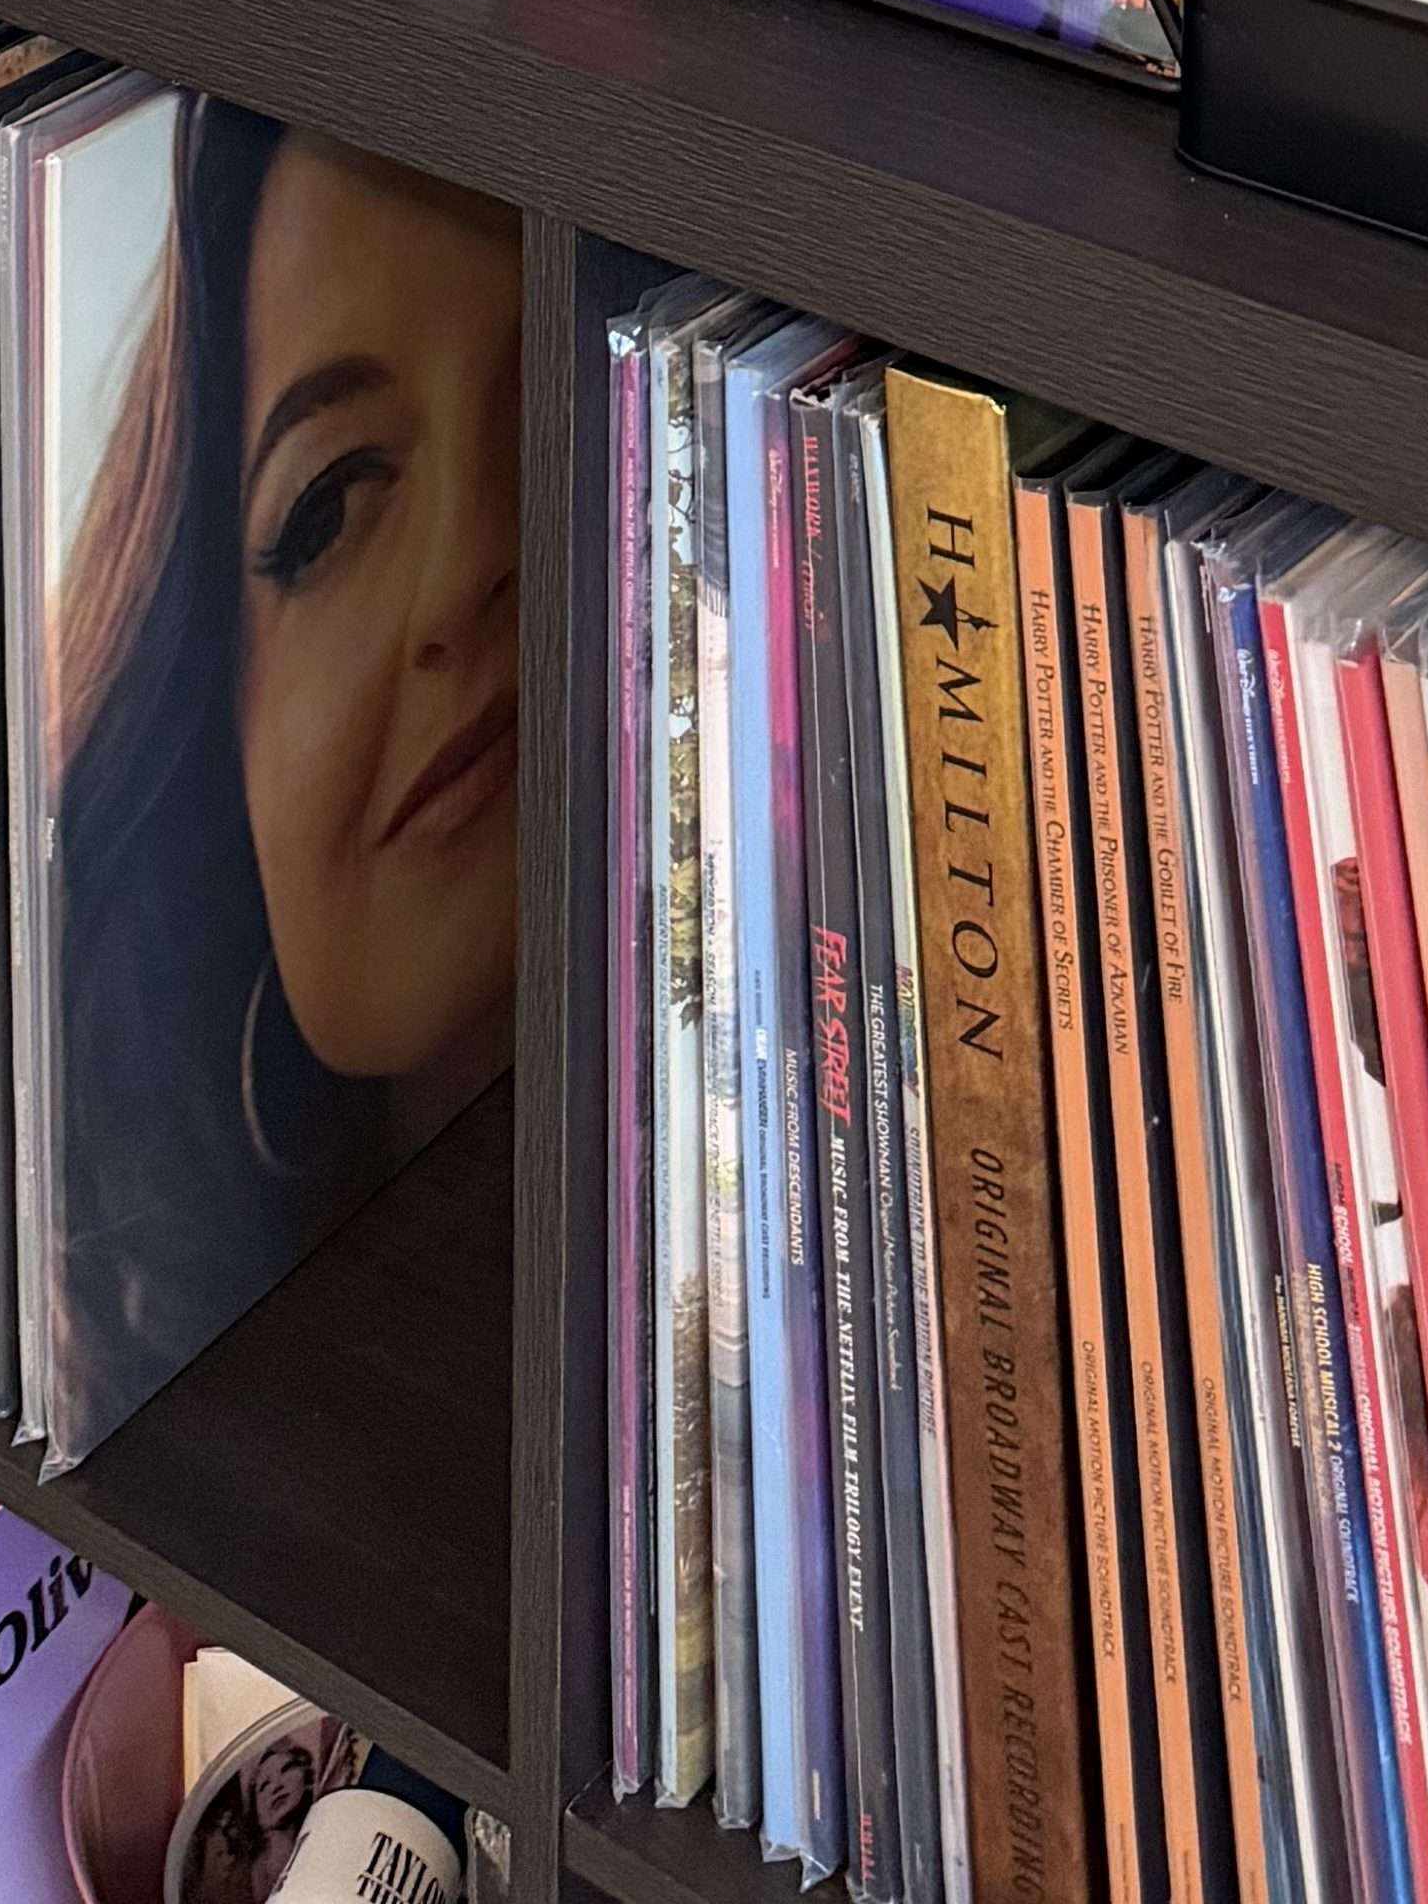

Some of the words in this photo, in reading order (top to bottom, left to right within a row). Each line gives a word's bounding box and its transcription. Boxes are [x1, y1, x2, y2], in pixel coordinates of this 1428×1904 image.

[1030, 590, 1052, 658] HARRY
[1079, 603, 1105, 672] HARRY
[1138, 615, 1160, 683] HARRY
[1034, 663, 1058, 739] POTTER
[1086, 678, 1110, 755] POTTER
[1143, 689, 1168, 766] POTTER
[1040, 744, 1056, 779] AND
[1093, 760, 1108, 794] AND
[1150, 772, 1166, 807] AND
[1043, 786, 1058, 813] THE
[1095, 800, 1110, 830] THE
[1153, 813, 1169, 841] THE
[1044, 820, 1069, 915] CHAMBER
[1096, 835, 1122, 928] PRISONER
[1156, 847, 1179, 927] GOBLET
[1052, 920, 1067, 945] OF
[1105, 932, 1120, 957] OF
[1162, 931, 1179, 957] OF
[811, 926, 850, 1015] FEAR
[869, 983, 884, 1012] THE
[1051, 948, 1077, 1030] SECRETS
[1165, 961, 1185, 1004] FIRE
[1107, 962, 1131, 1054] AZKABAN
[784, 1048, 799, 1099] MUSIC
[816, 1018, 853, 1128] STREET
[870, 1017, 888, 1095] GREATEST
[786, 1101, 800, 1148] FROM
[873, 1100, 892, 1188] SHOWMAN
[830, 1134, 847, 1201] MUSIC
[786, 1150, 804, 1265] DESCENDANTS
[832, 1204, 849, 1264] FROM
[969, 1147, 1013, 1331] ORIGINAL
[836, 1272, 851, 1313] THE
[1306, 1263, 1325, 1303] HIGH
[837, 1320, 855, 1405] NETFLIX
[1311, 1306, 1333, 1366] SCHOOL
[1081, 1340, 1100, 1413] ORIGINAL
[1139, 1360, 1158, 1434] ORIGINAL
[1319, 1369, 1340, 1436] MUSICAL
[841, 1413, 857, 1463] FILM
[1201, 1377, 1220, 1449] ORIGINAL
[981, 1347, 1026, 1568] BROADWAY
[1086, 1416, 1104, 1483] MOTION
[1145, 1439, 1164, 1505] MOTION
[1328, 1454, 1349, 1513] ORIGINAL
[842, 1470, 861, 1559] TRILOGY
[1091, 1487, 1109, 1550] PICTURE
[1208, 1456, 1227, 1523] MOTION
[1213, 1527, 1233, 1596] PICTURE
[1335, 1517, 1360, 1602] SOUNDTRACK
[847, 1564, 864, 1632] EVENT
[994, 1581, 1032, 1675] CAST
[1095, 1555, 1116, 1659] SOUNDTRACK
[1155, 1577, 1178, 1685] SOUNDTRACK
[1219, 1597, 1243, 1703] SOUNDTRACK
[1000, 1683, 1044, 1896] RECORDING
